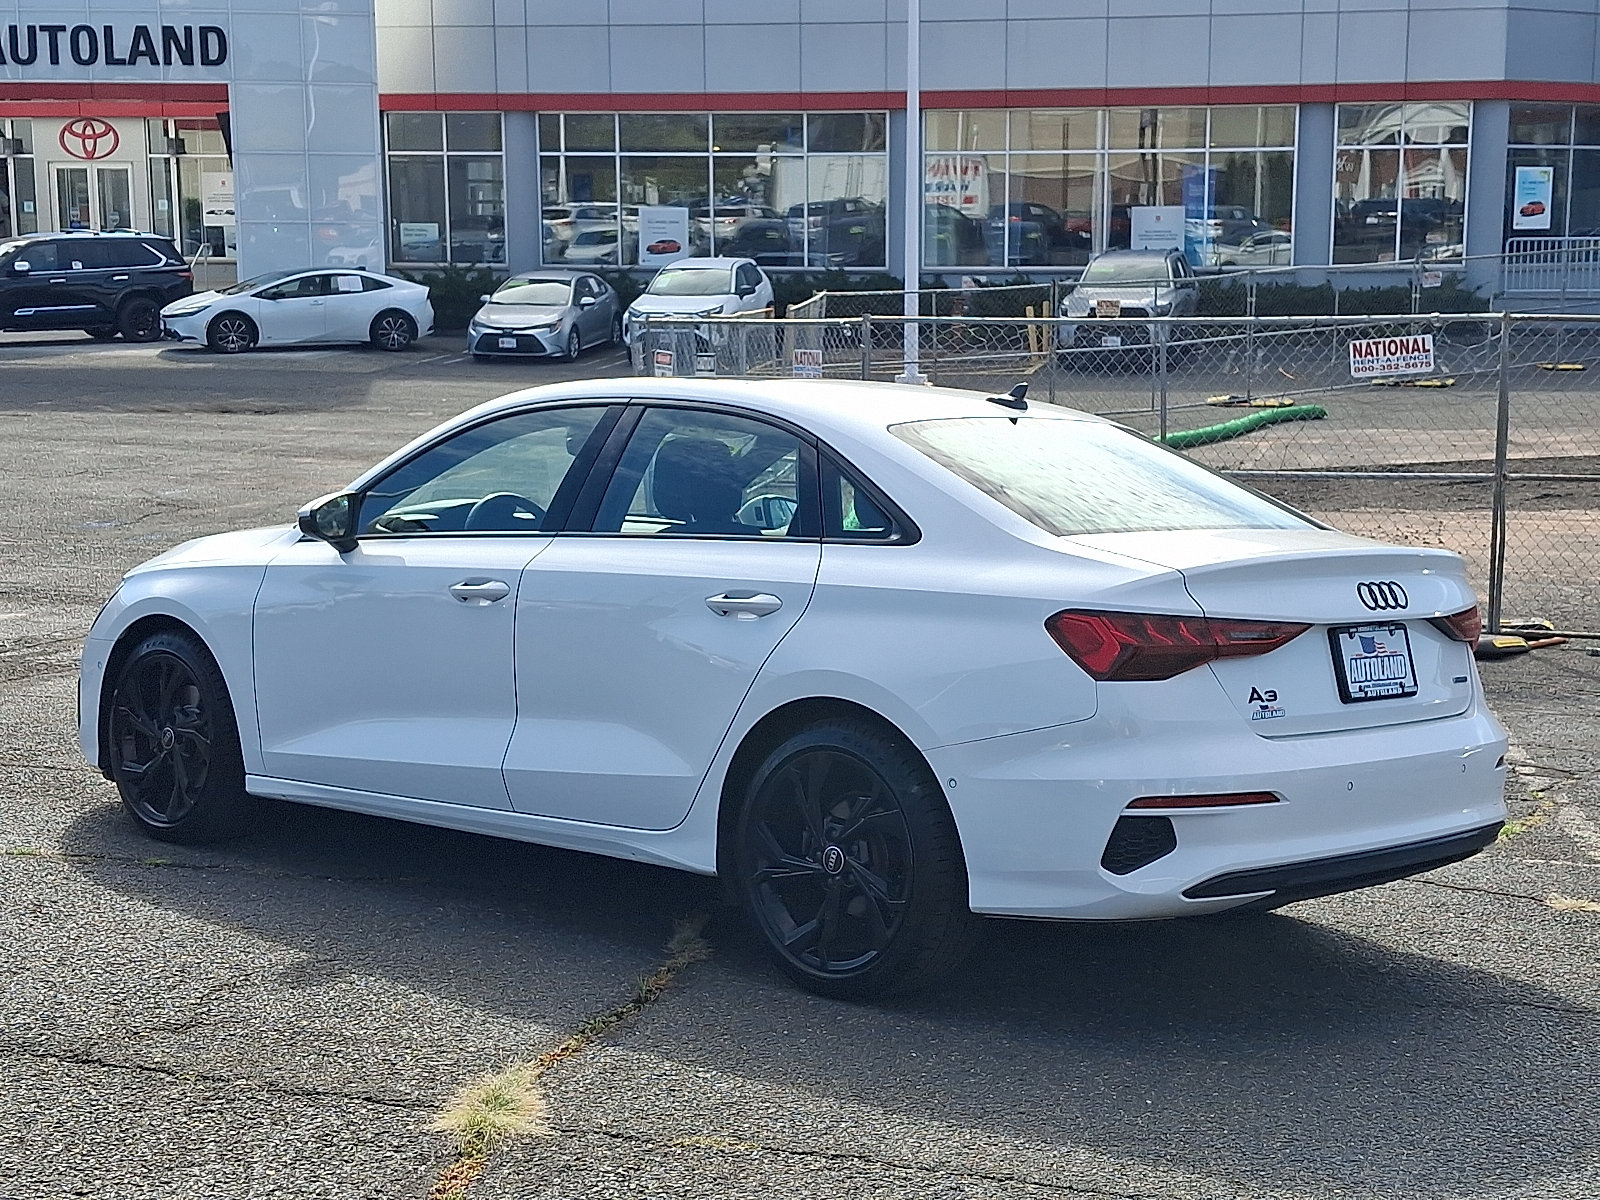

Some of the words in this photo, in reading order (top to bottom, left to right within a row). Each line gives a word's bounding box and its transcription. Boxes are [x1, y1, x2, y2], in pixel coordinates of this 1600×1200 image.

[0, 24, 228, 66] UTOLAND
[1352, 336, 1430, 358] NATIONAL
[1353, 354, 1431, 366] RENT-A-FENCE
[1350, 656, 1406, 682] AUTOLAND
[1248, 686, 1278, 704] A3
[1367, 687, 1402, 696] AUTOLAND
[1252, 709, 1285, 720] AUTOLAND
